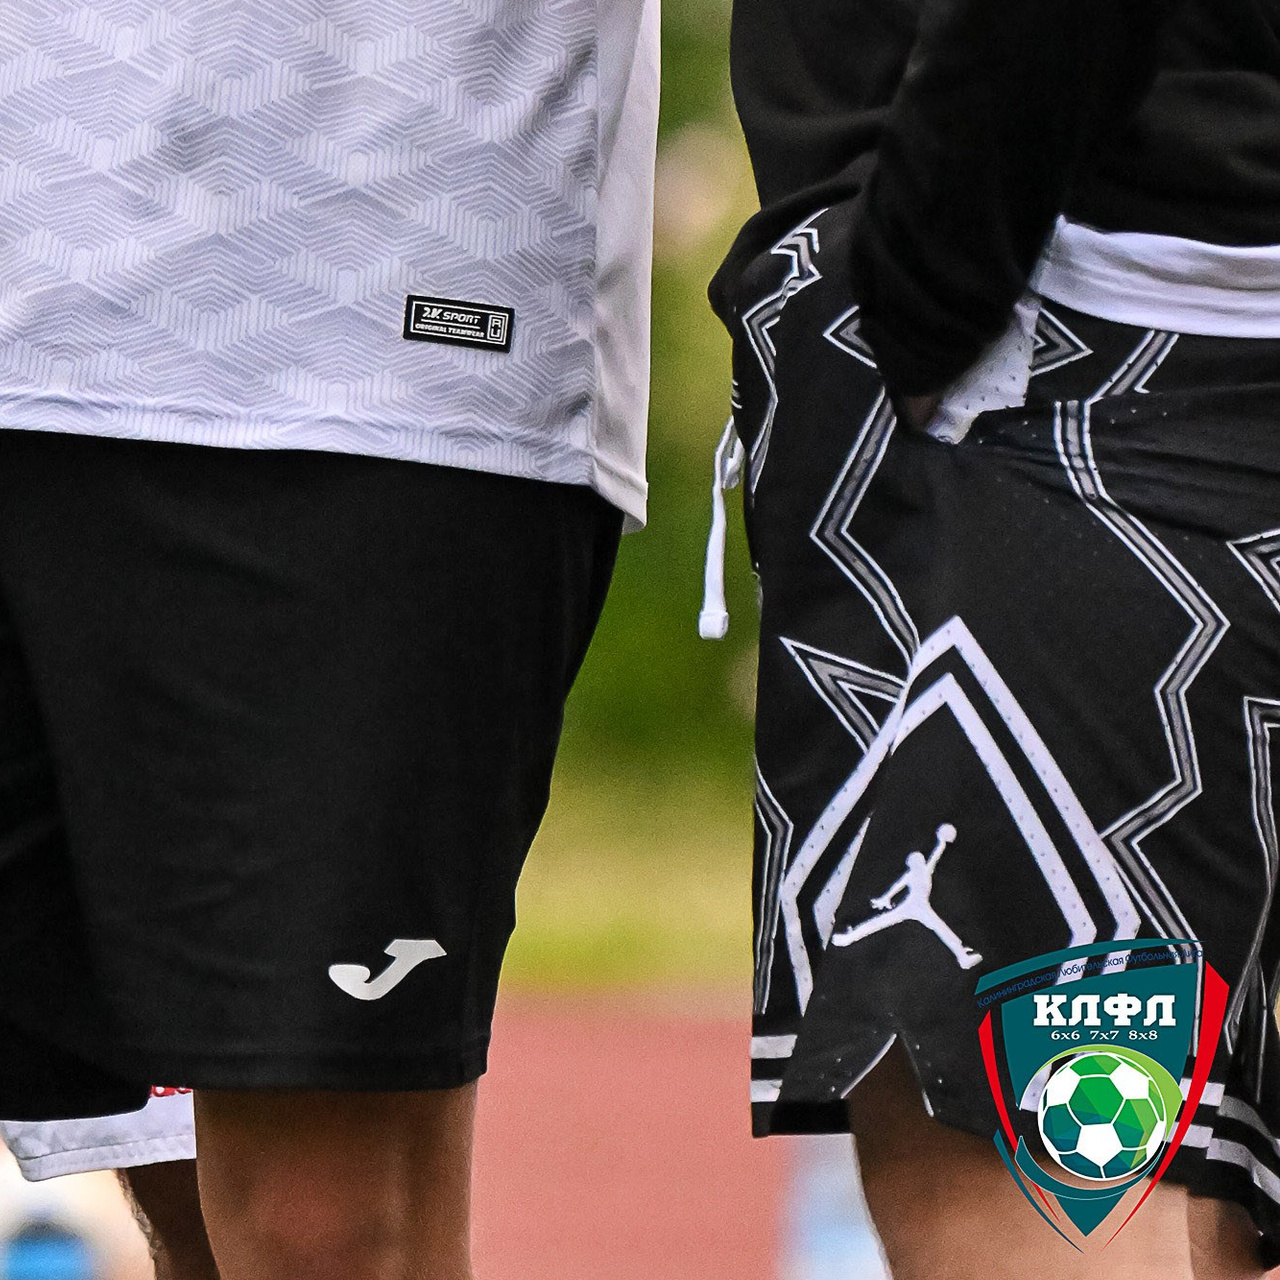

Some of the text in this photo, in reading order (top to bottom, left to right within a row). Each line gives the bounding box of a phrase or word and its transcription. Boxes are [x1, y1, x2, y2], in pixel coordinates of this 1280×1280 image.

[442, 311, 481, 325] SPORT
[414, 323, 485, 338] ORIGINAL TEAMWEAR
